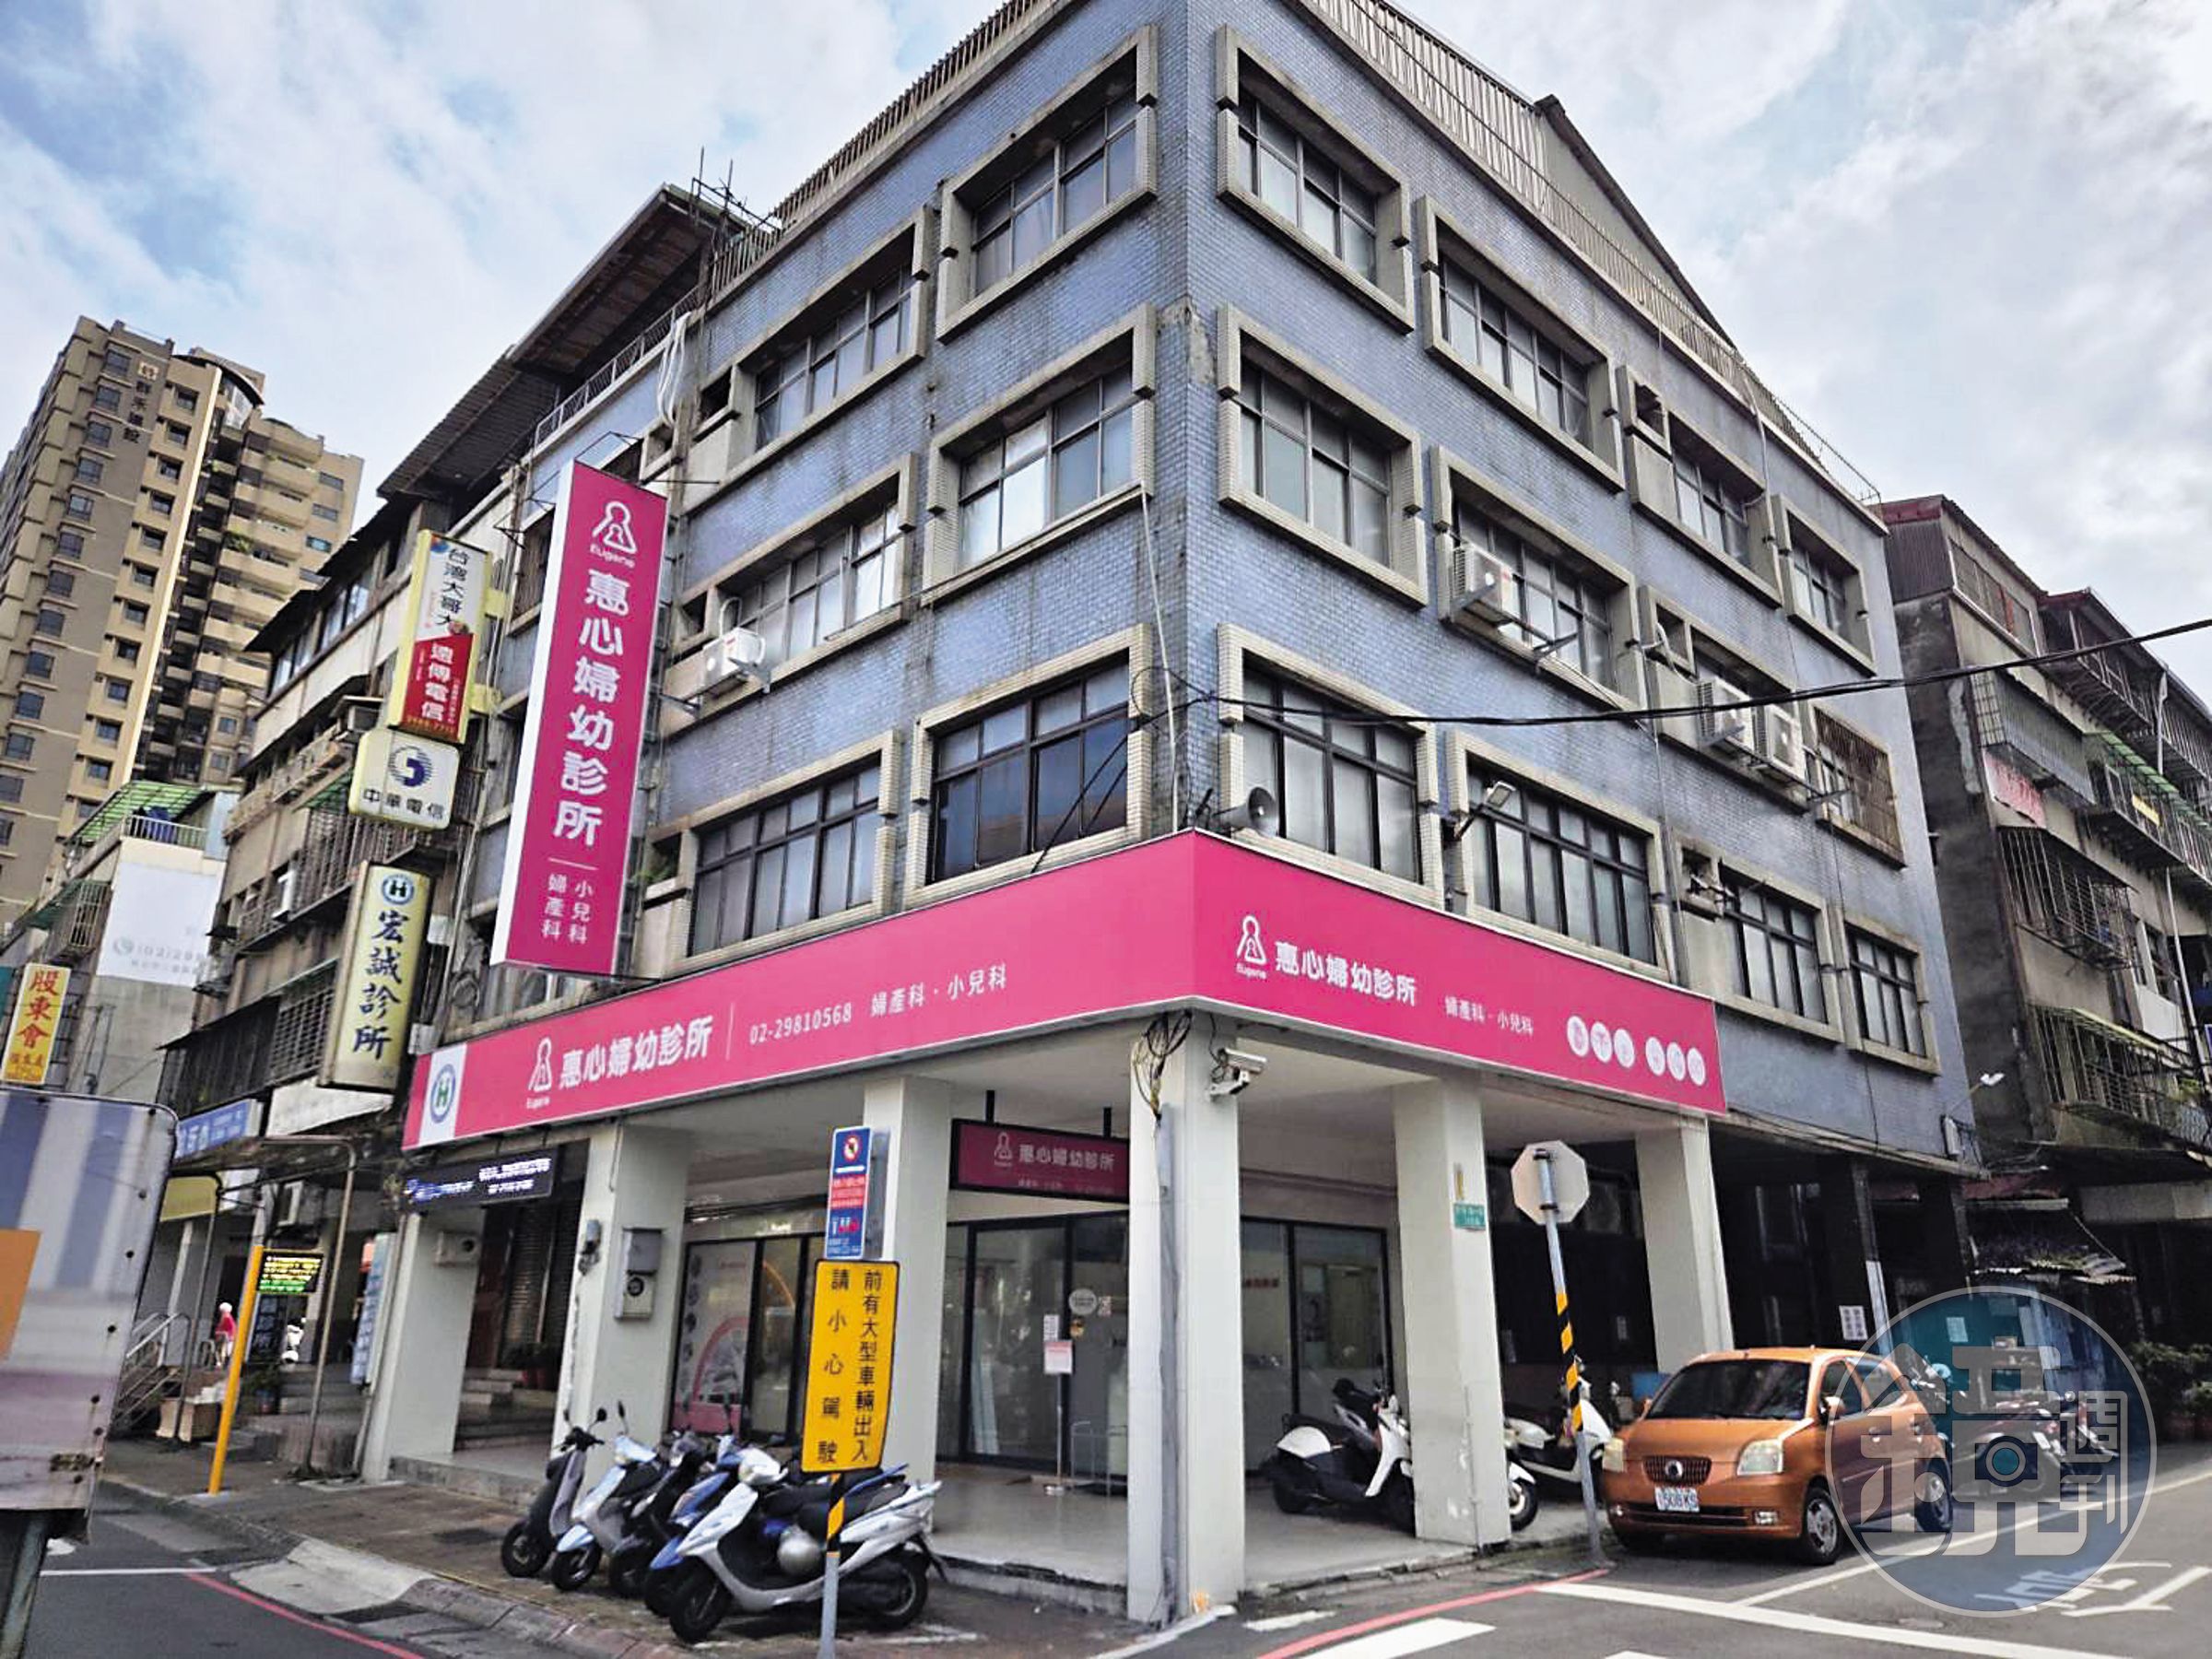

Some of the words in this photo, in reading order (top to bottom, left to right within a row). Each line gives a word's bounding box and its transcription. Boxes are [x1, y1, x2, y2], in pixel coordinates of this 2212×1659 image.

[554, 568, 631, 848] 惠心婦幼診所
[363, 788, 445, 820] 中華電信
[540, 873, 568, 940] 婦產科
[569, 880, 594, 945] 小兒科
[353, 909, 410, 1061] 宏誠診所
[1275, 941, 1418, 1007] 惠心婦幼診所
[558, 1016, 713, 1090] 惠心婦幼診所
[749, 1002, 853, 1045] 02-29810568
[817, 1268, 851, 1465] 請小心駕駛
[851, 1270, 882, 1463] 前有大型車輛出入
